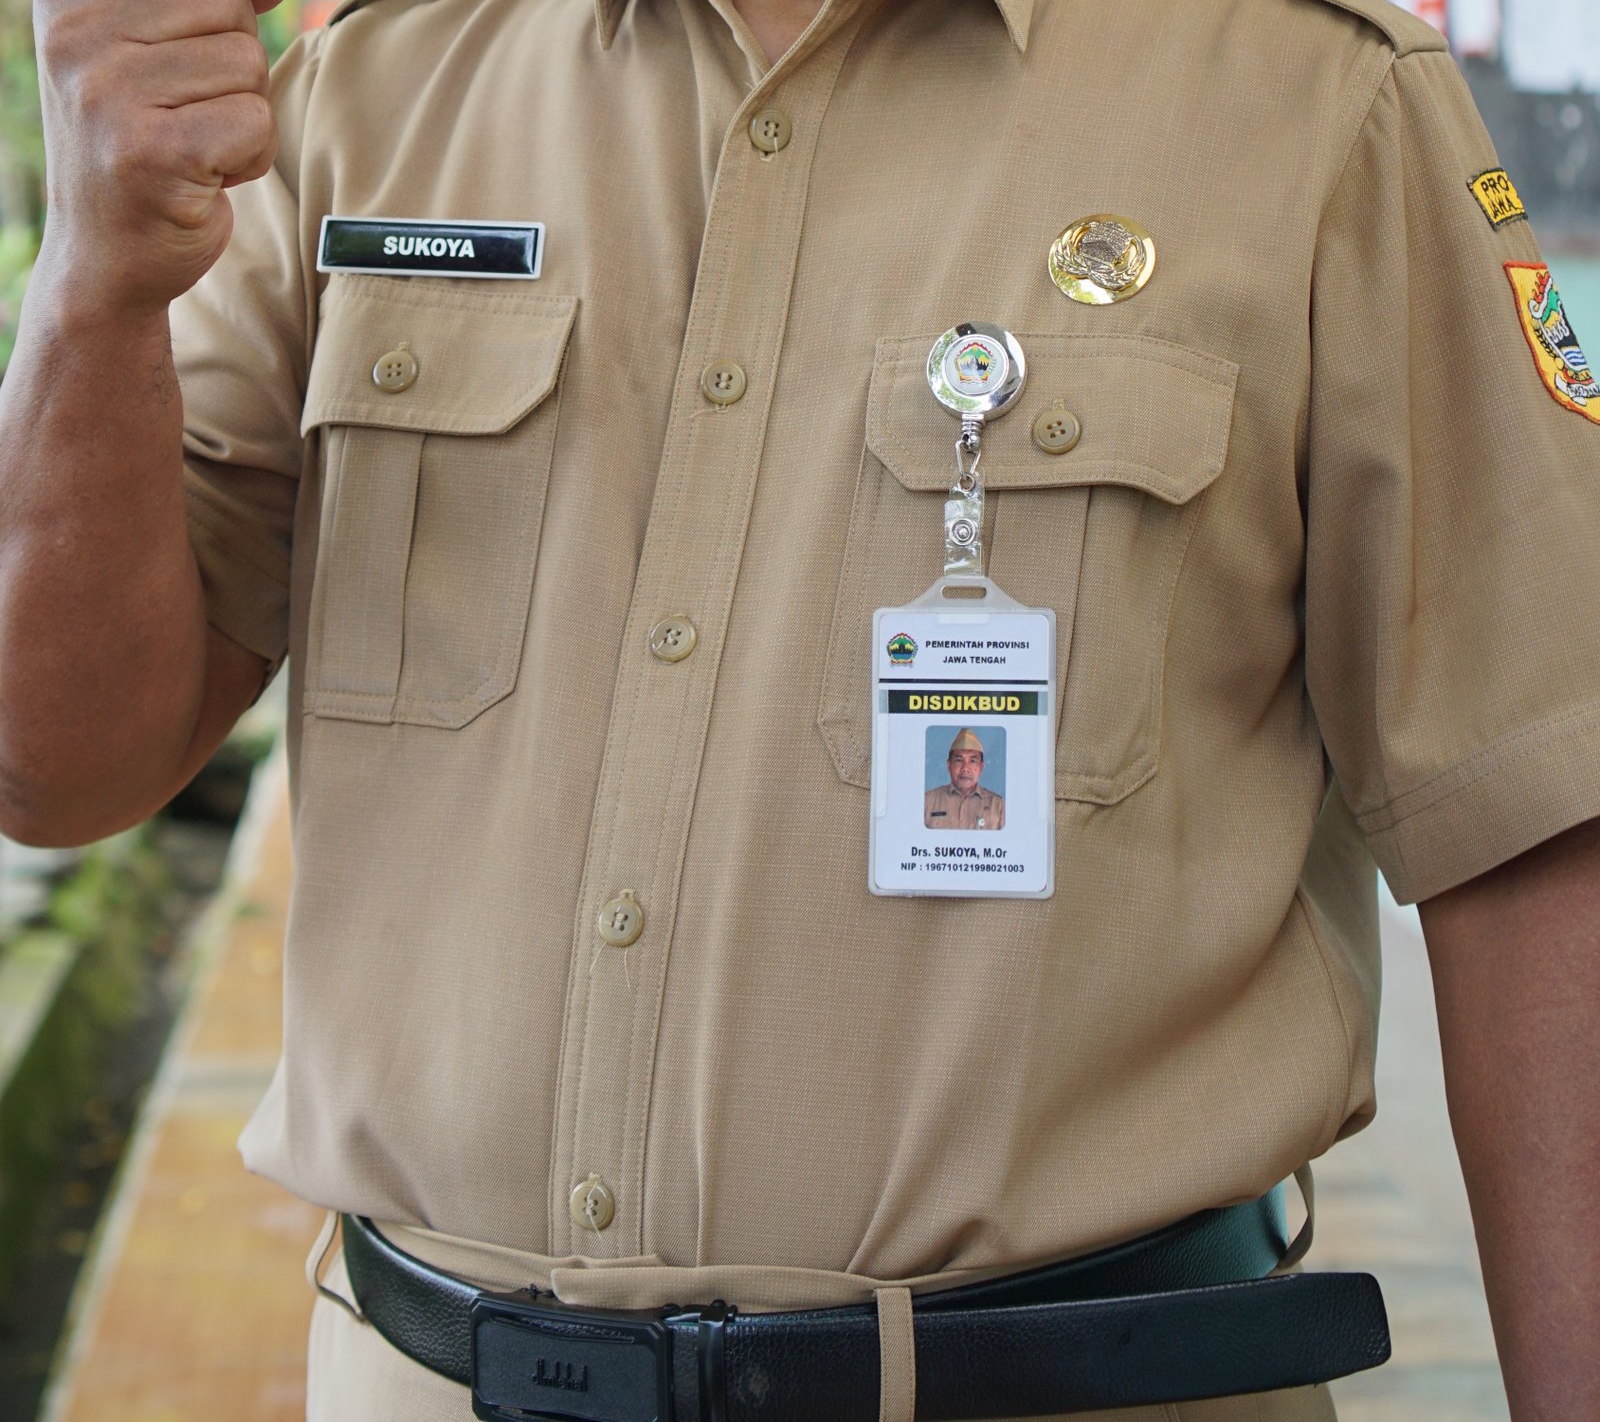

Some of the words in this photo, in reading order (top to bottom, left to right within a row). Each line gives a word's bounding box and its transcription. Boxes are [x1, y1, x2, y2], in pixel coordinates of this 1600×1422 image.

[383, 236, 475, 258] SUKOYA
[925, 640, 984, 649] PEMERINTAH
[986, 641, 1030, 649] PROVINSI
[942, 656, 968, 664] JAWA
[969, 656, 1006, 664] TENGAH
[909, 695, 1020, 712] DISDIKBUD
[911, 846, 931, 857] Drs.
[934, 846, 980, 859] SUKOYA,
[983, 847, 1007, 858] M.Or
[900, 862, 917, 871] NIP
[925, 862, 1025, 873] 196710121998021003
